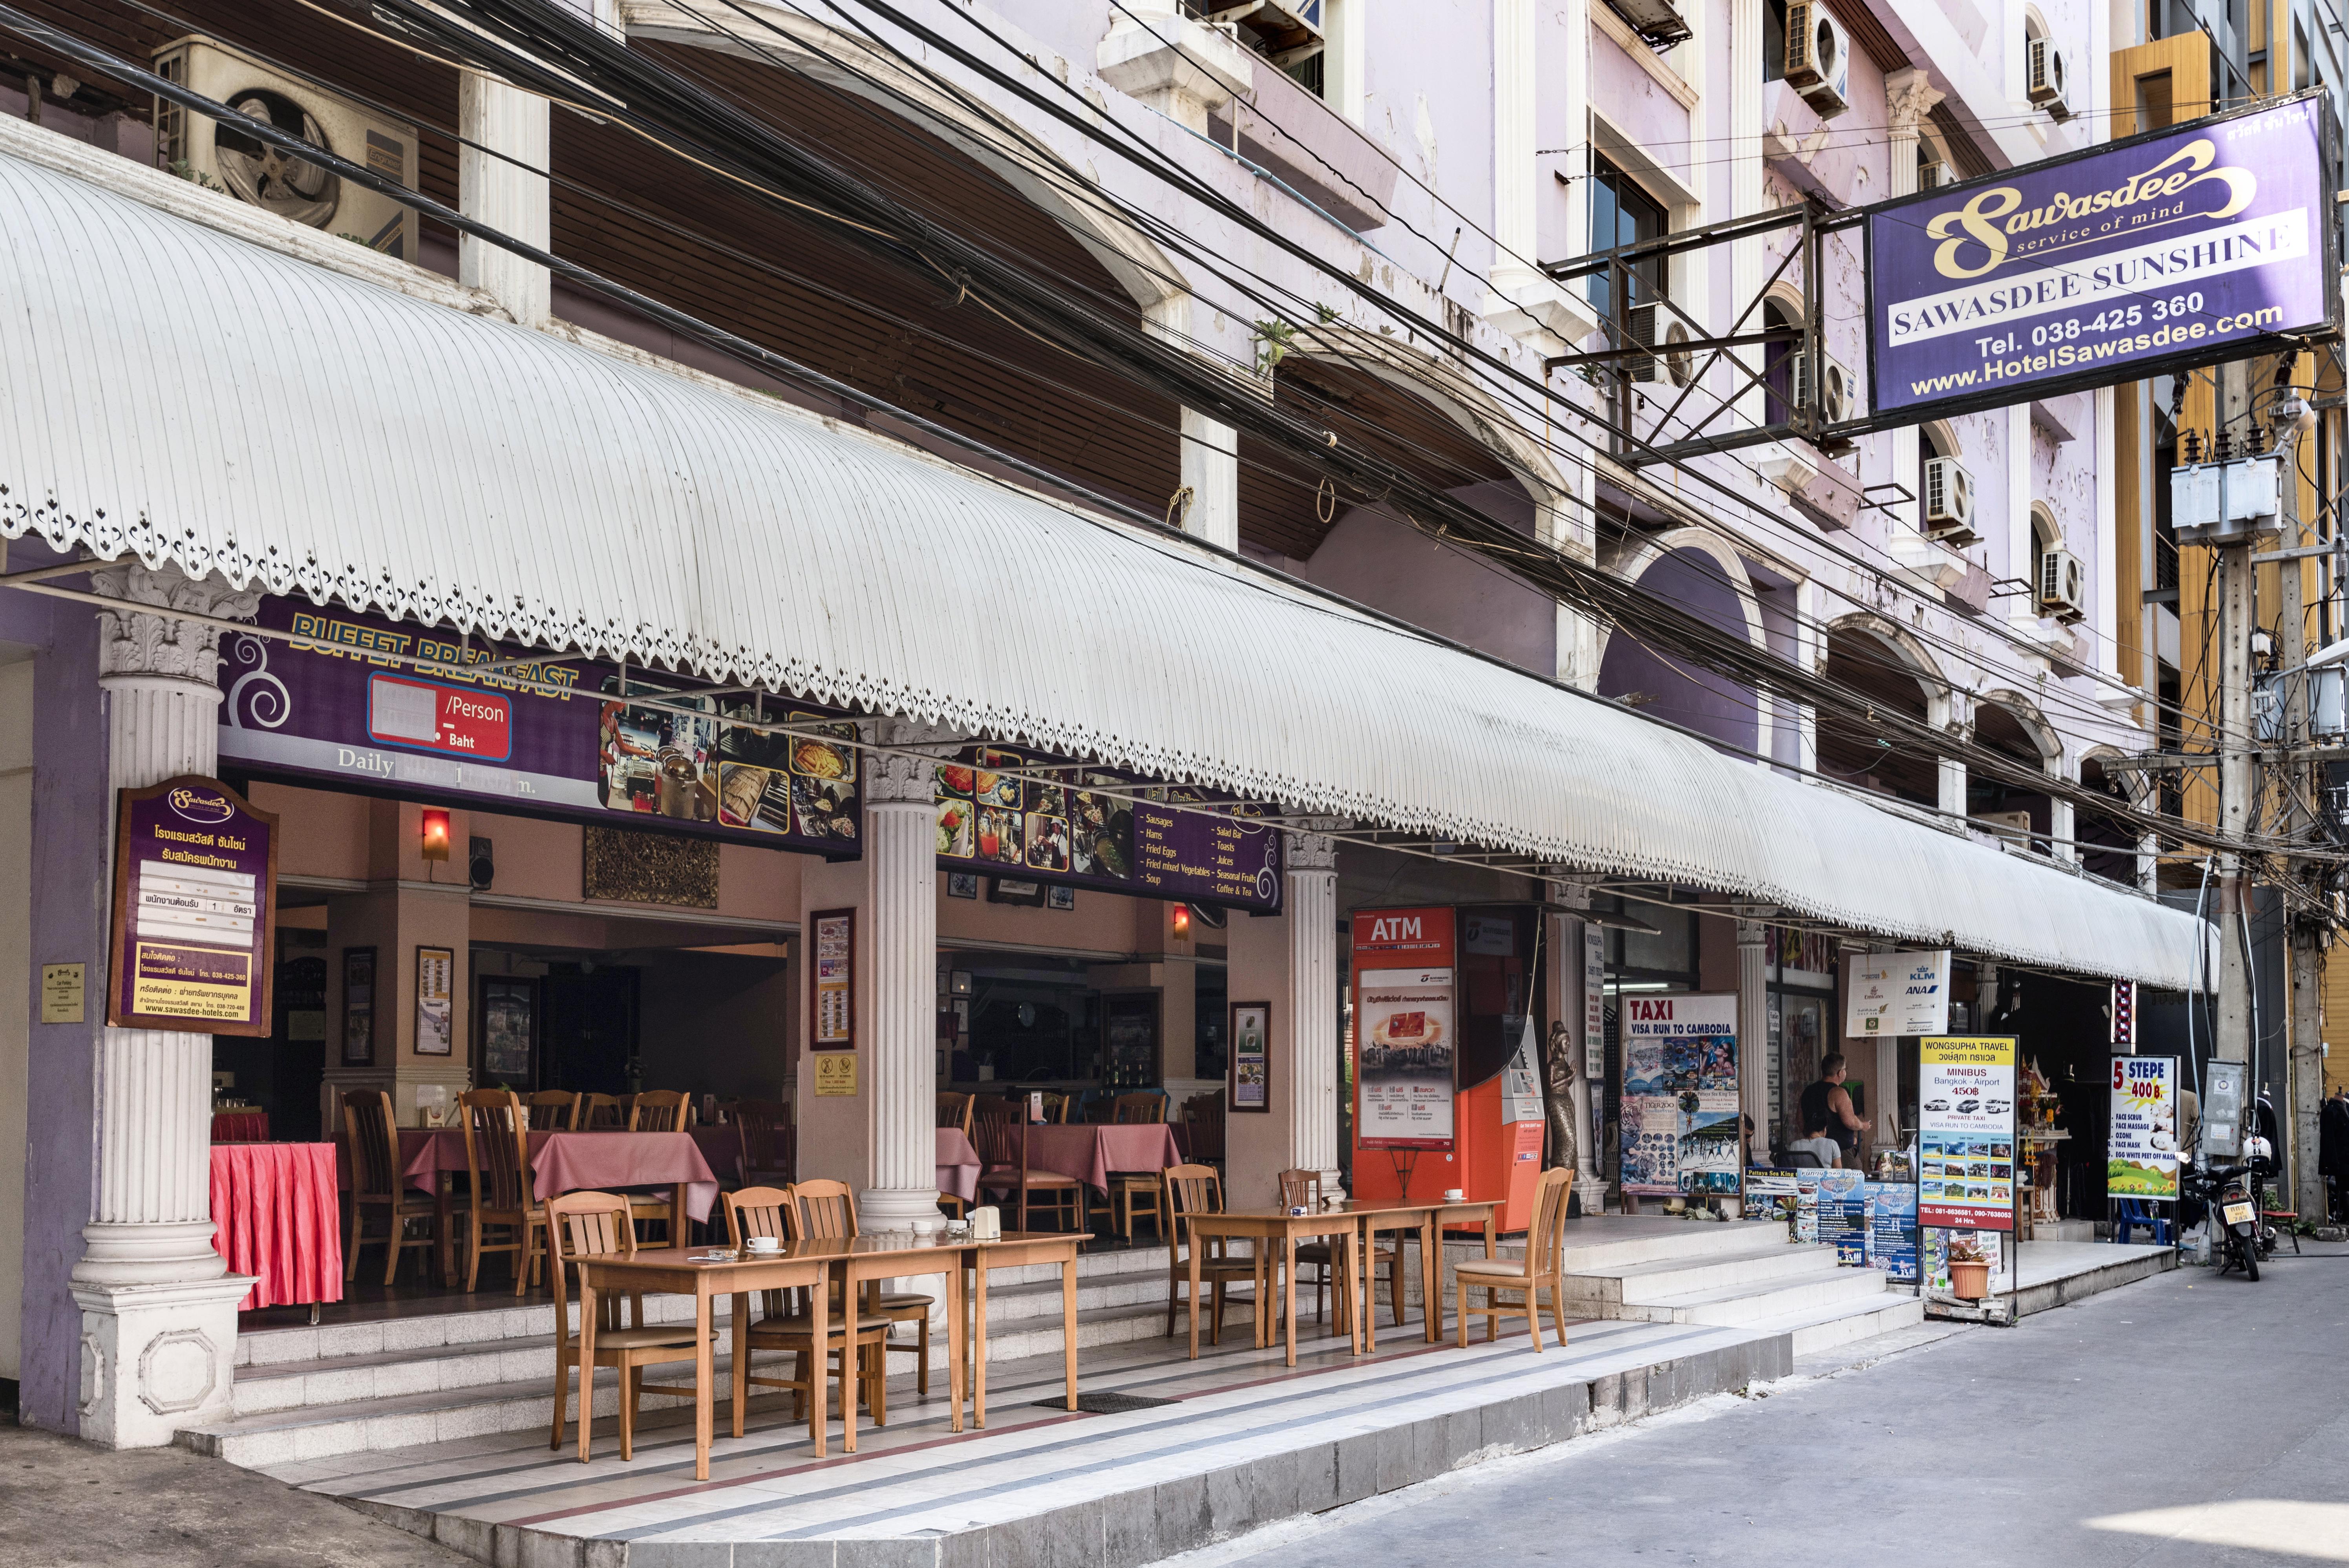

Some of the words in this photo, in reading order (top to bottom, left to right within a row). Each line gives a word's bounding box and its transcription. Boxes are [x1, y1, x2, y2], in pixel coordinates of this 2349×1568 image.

[370, 150, 400, 168] Engineer
[1926, 139, 2257, 279] Sawasdee
[2017, 225, 2090, 252] service
[2100, 215, 2123, 233] of
[2131, 201, 2184, 225] mind
[1894, 272, 2082, 336] SAWASDEE
[2092, 224, 2290, 291] SUNSHINE
[1976, 334, 2022, 358] Tel.
[2032, 305, 2143, 347] 038-425
[2152, 292, 2204, 321] 360
[1911, 303, 2283, 396] www.HotelSawasdee.com
[289, 612, 411, 669] BUFFET
[446, 696, 504, 724] /Person
[450, 733, 475, 749] Baht
[338, 748, 394, 778] Daily
[174, 790, 231, 815] Sawasdee
[1146, 814, 1173, 827] Sausages
[155, 824, 214, 846] โรงแรมสวัสดี
[218, 836, 246, 850] ซันไชน์
[1146, 829, 1162, 840] Hams
[1217, 826, 1231, 837] Salad
[1233, 829, 1242, 839] Bar
[1146, 844, 1161, 854] Fried
[1163, 846, 1176, 857] Eggs
[1217, 841, 1234, 852] Toasts
[162, 848, 236, 869] รับสมัครพนักงาน
[1217, 855, 1233, 866] Juices
[1146, 859, 1161, 869] Fried
[1163, 862, 1179, 872] mixed
[1181, 864, 1210, 877] Vegetables
[1146, 874, 1161, 886] Soup
[1217, 870, 1240, 881] Seasonal
[1242, 872, 1256, 883] Fruits
[1217, 884, 1233, 894] Coffee
[1236, 886, 1239, 895] &
[1243, 887, 1252, 896] Tea
[146, 895, 199, 908] พนักงานต้อนรับ
[234, 905, 251, 914] อัตรา
[1371, 917, 1421, 941] ATM
[141, 951, 175, 961] สนใจติดต่อ
[141, 964, 175, 974] โรงแรมสวัสดี
[212, 972, 246, 980] 038-425-360
[140, 985, 172, 994] หรือติดต่อ
[180, 987, 238, 1001] ฝ่ายทรัพยากรบุคคล
[1905, 986, 1927, 994] ANA
[146, 1005, 238, 1018] www.sawasdee-hotels.com
[1630, 1000, 1673, 1020] TAXI
[1632, 1024, 1650, 1034] VISA
[1653, 1024, 1670, 1034] RUN
[1673, 1024, 1684, 1034] TO
[1687, 1024, 1731, 1034] CAMBODIA
[1925, 1042, 1976, 1050] WONGSUPHA
[1939, 1052, 1967, 1063] วงษ์สุภา
[1947, 1068, 1987, 1076] MINIBUS
[2113, 1061, 2123, 1089] 5
[2129, 1062, 2164, 1078] STEPE
[1934, 1077, 1967, 1086] Bangkok
[1974, 1078, 2000, 1086] Airport
[2132, 1082, 2152, 1098] 400
[1935, 1208, 1973, 1217] 081-8636581,
